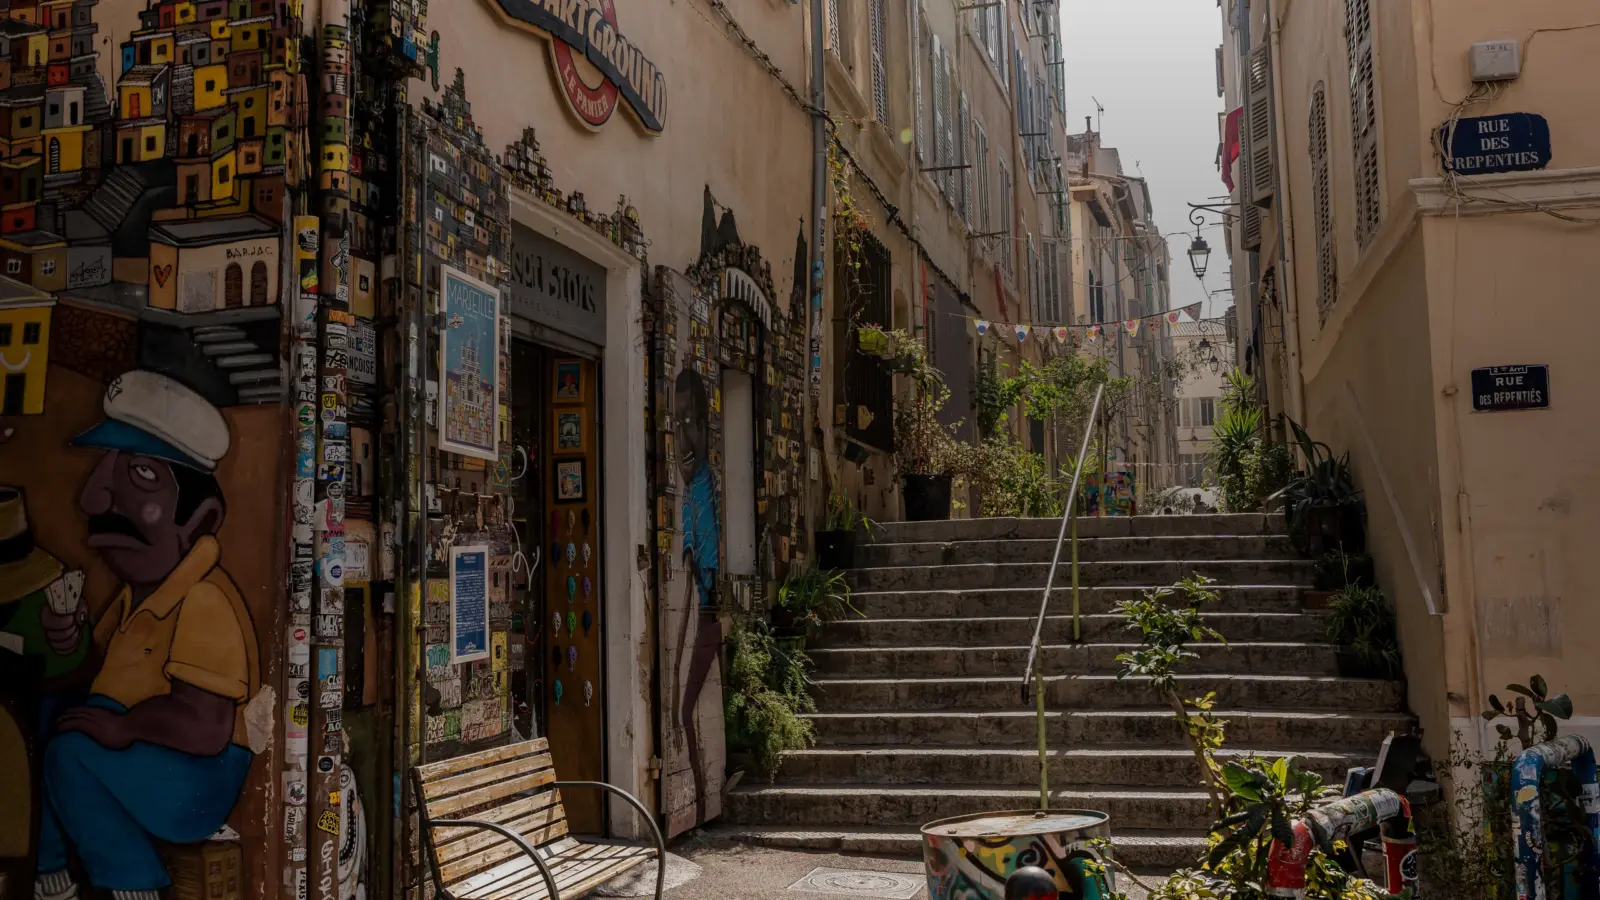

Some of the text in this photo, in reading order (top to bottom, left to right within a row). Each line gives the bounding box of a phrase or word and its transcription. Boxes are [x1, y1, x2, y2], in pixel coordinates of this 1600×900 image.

[528, 0, 667, 127] ARTGROUND
[563, 63, 609, 119] LE PANIER
[1477, 119, 1510, 134] RUE
[1480, 136, 1510, 151] DES
[1455, 151, 1539, 170] REPENTIES
[226, 246, 273, 259] BARJAC
[447, 281, 495, 321] MARSEILLE
[1495, 376, 1524, 387] RUE
[1479, 394, 1492, 405] DES
